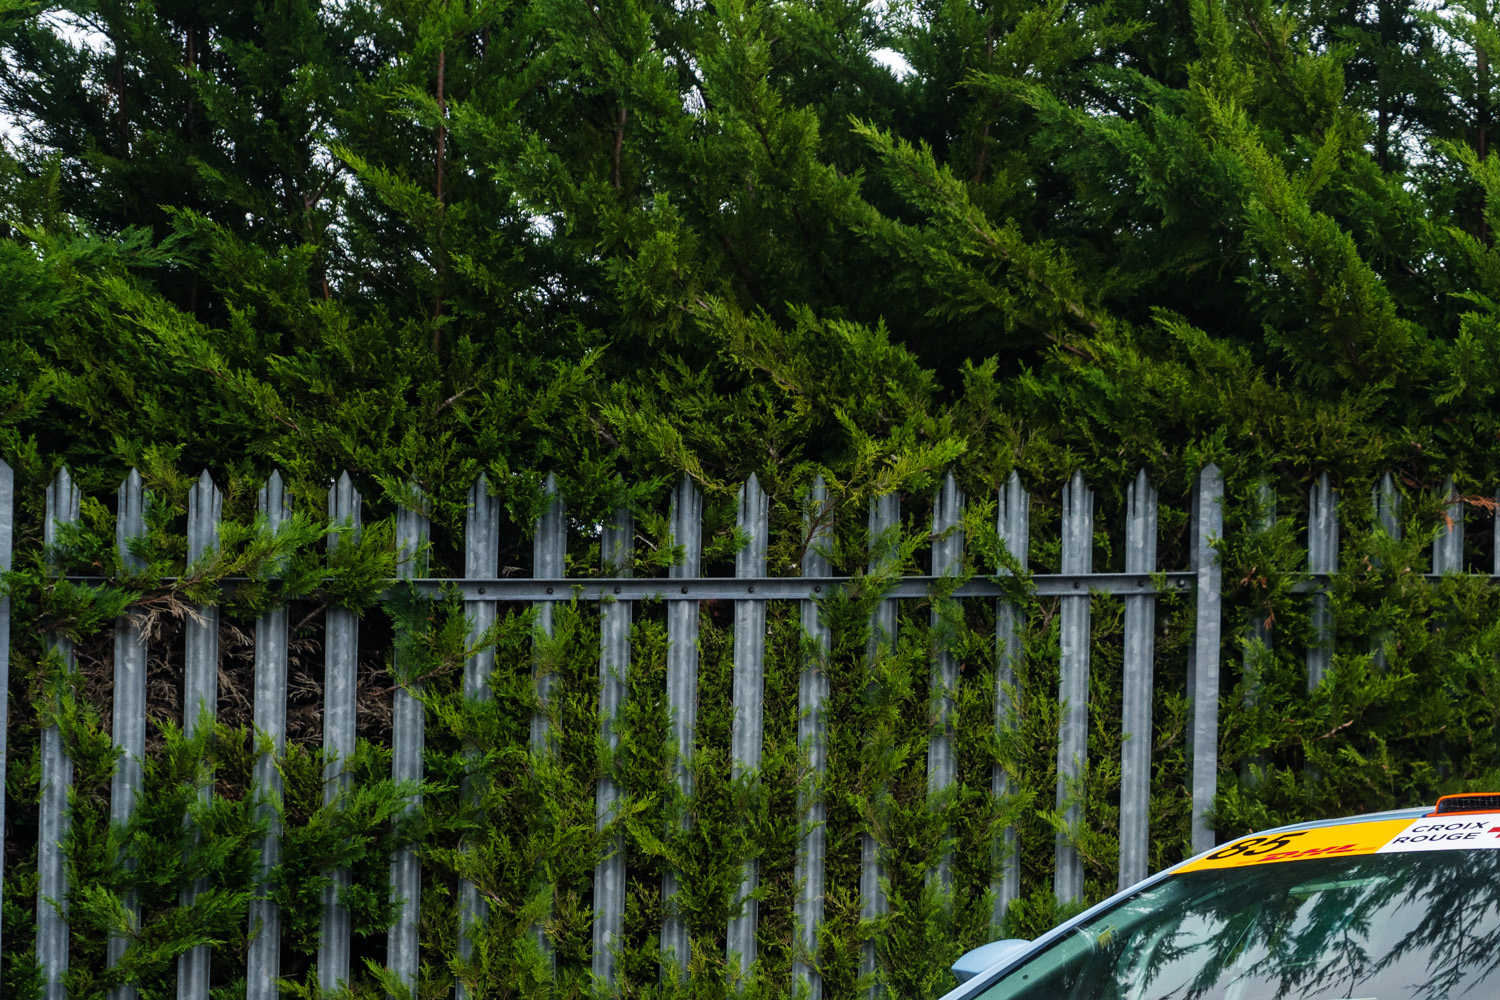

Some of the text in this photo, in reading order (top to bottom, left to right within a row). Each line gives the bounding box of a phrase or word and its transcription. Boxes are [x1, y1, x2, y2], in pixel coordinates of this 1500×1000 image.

[1412, 821, 1489, 833] CROIX
[1206, 831, 1310, 860] 85
[1392, 831, 1482, 844] ROUGE
[1257, 843, 1359, 862] DHL
